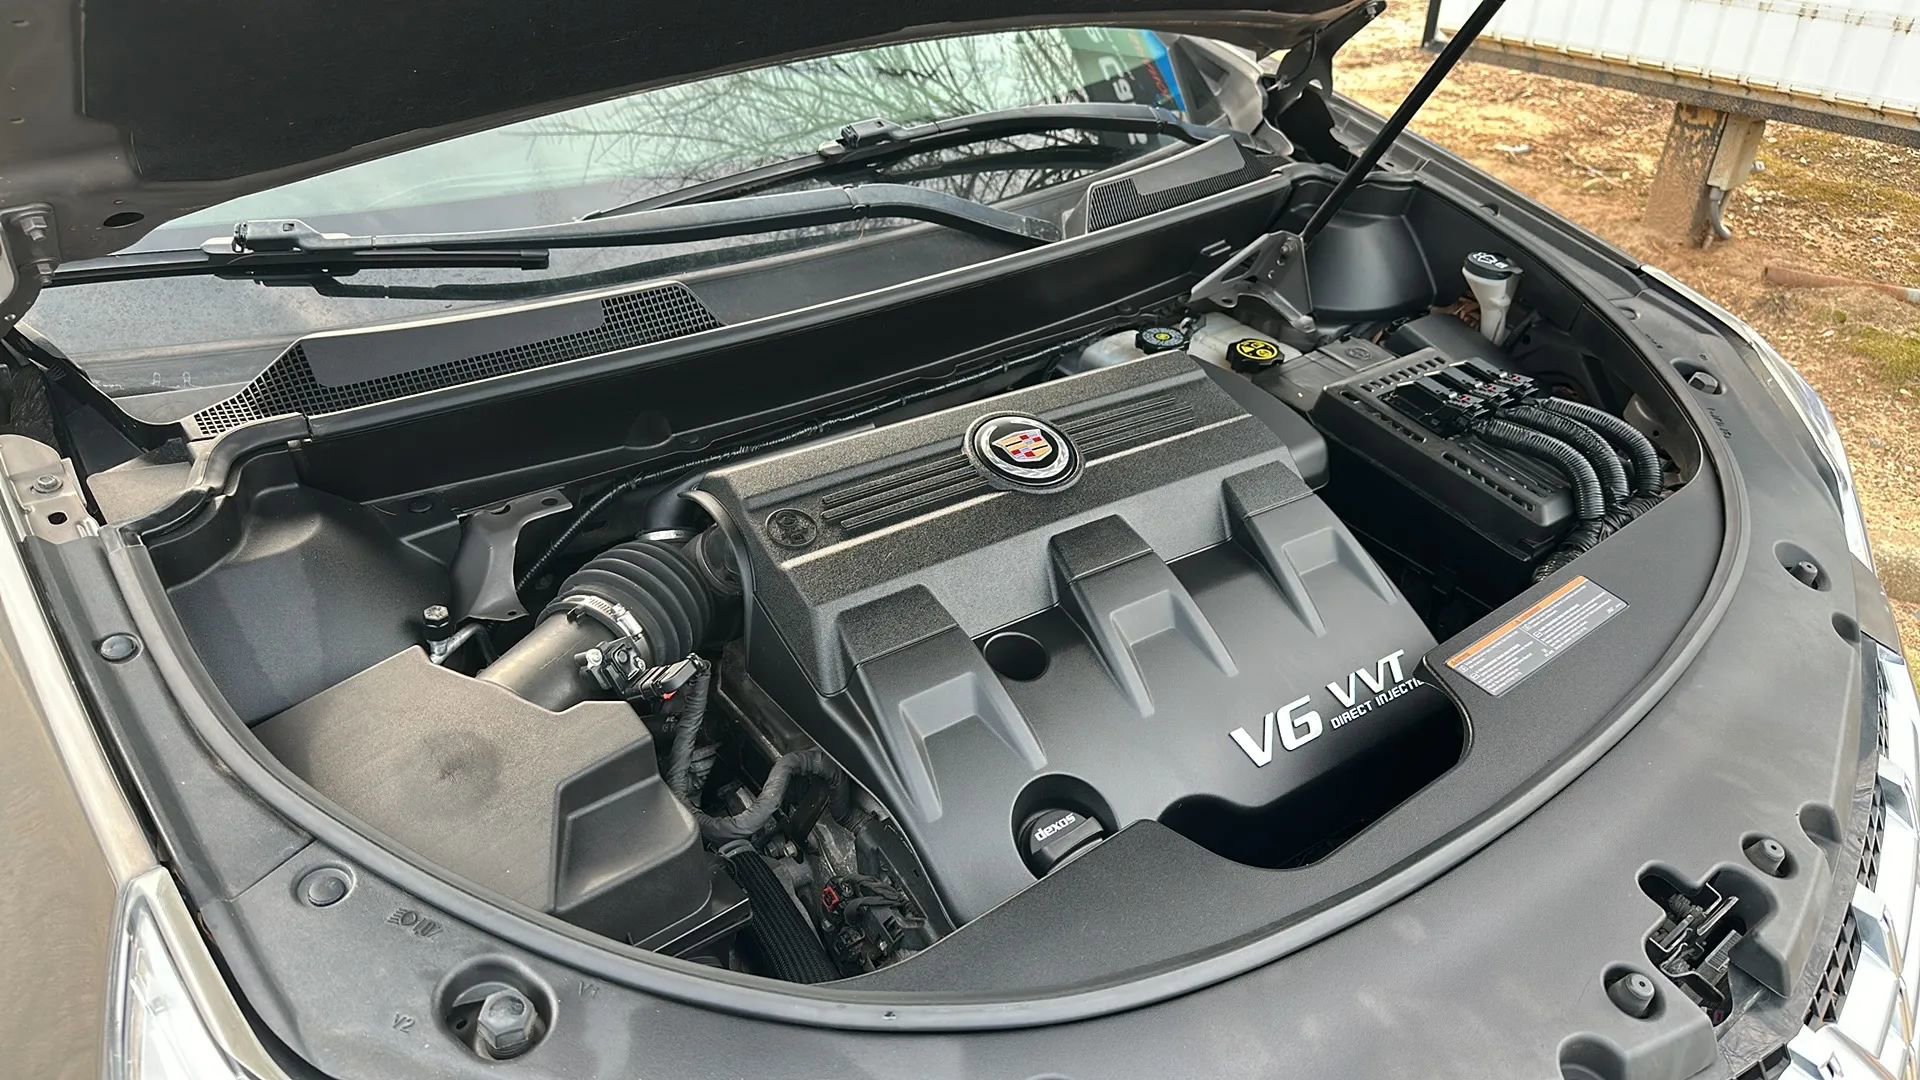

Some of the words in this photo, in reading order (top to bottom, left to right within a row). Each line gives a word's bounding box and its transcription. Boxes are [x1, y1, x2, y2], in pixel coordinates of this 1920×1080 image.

[1229, 694, 1323, 768] V6
[1326, 649, 1405, 708] VVT
[1330, 700, 1373, 730] DIRECT
[1034, 812, 1076, 841] dexos
